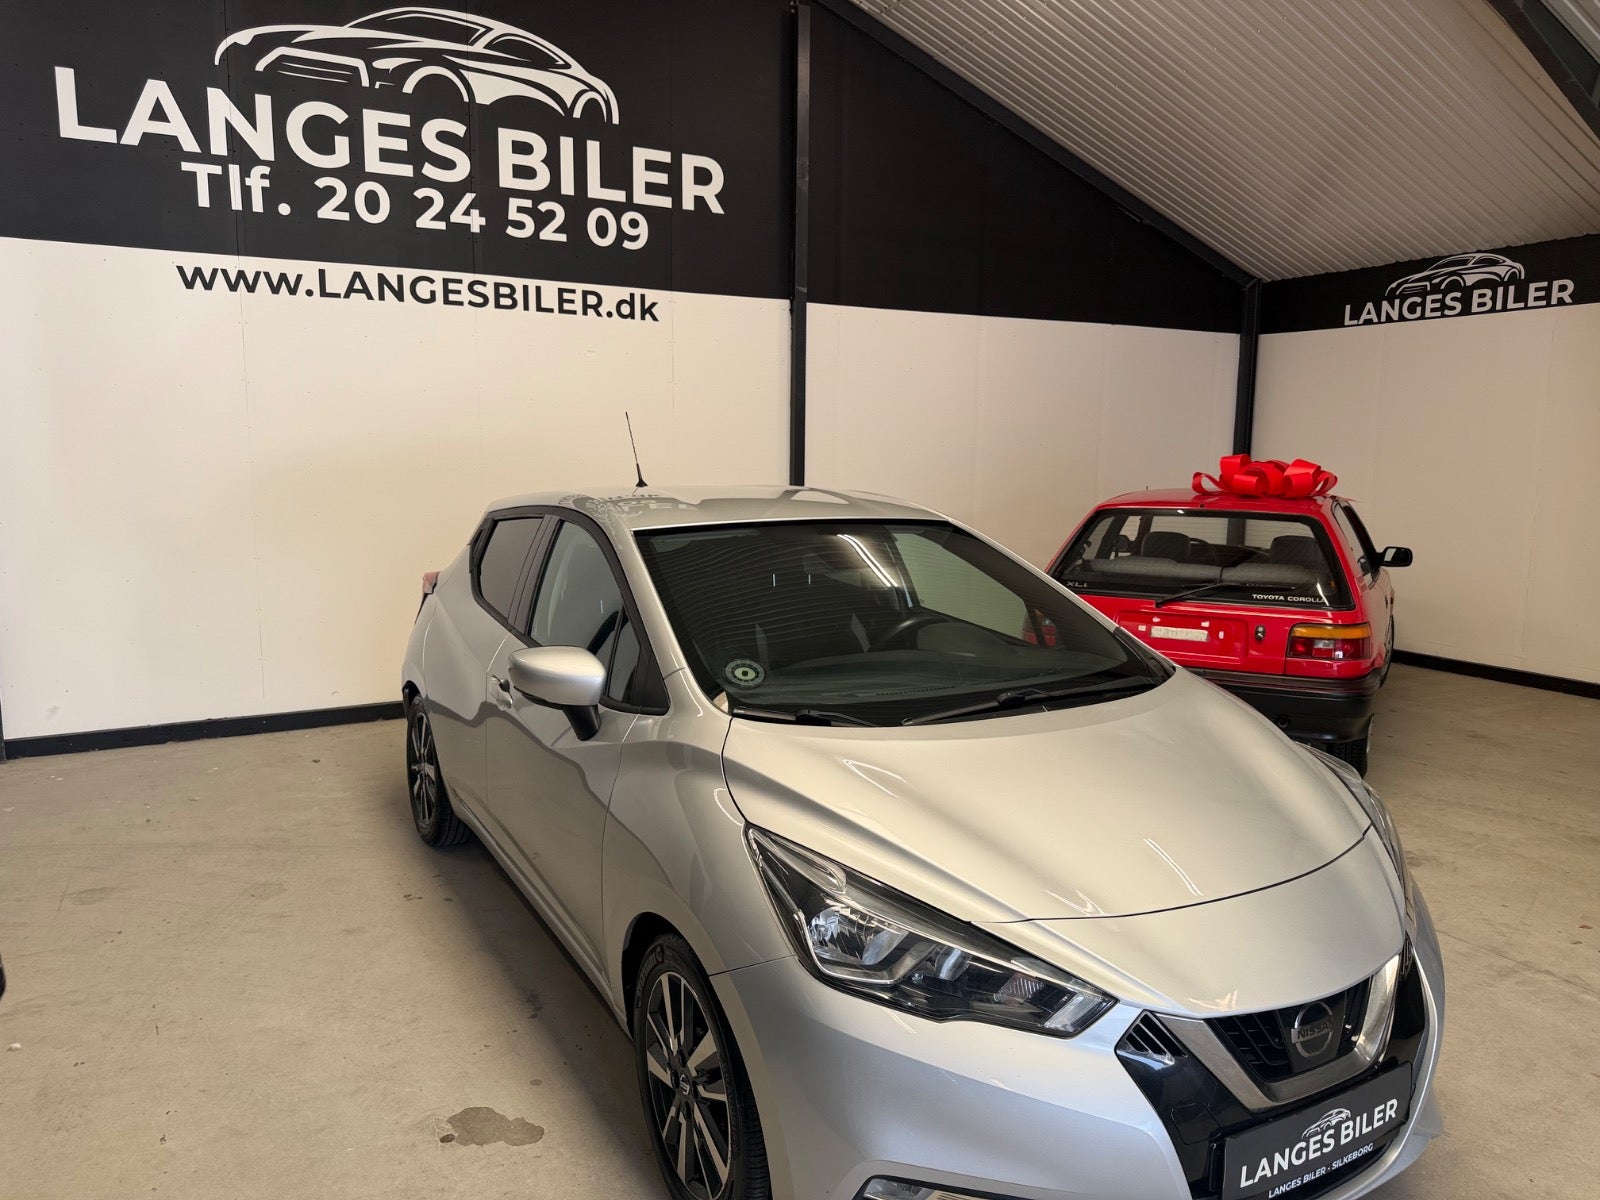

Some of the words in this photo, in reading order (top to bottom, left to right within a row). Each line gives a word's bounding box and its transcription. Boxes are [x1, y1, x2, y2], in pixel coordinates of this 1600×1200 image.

[55, 66, 471, 183] LANGES
[497, 127, 725, 215] BILER
[180, 162, 291, 216] Tlf.
[313, 176, 391, 224] 20
[413, 187, 486, 234] 24
[505, 197, 568, 243] 52
[586, 207, 649, 250] 09
[176, 265, 659, 322] www.LANGESBILER.dk
[1344, 291, 1462, 326] LANGES
[1471, 279, 1575, 313] BILER
[1297, 1020, 1332, 1039] NISSA
[1240, 1128, 1335, 1188] LANGES
[1340, 1098, 1398, 1146] BILER
[1268, 1177, 1302, 1199] LANGES
[1303, 1166, 1326, 1184] BILER
[1332, 1142, 1374, 1170] SILKEBORG
